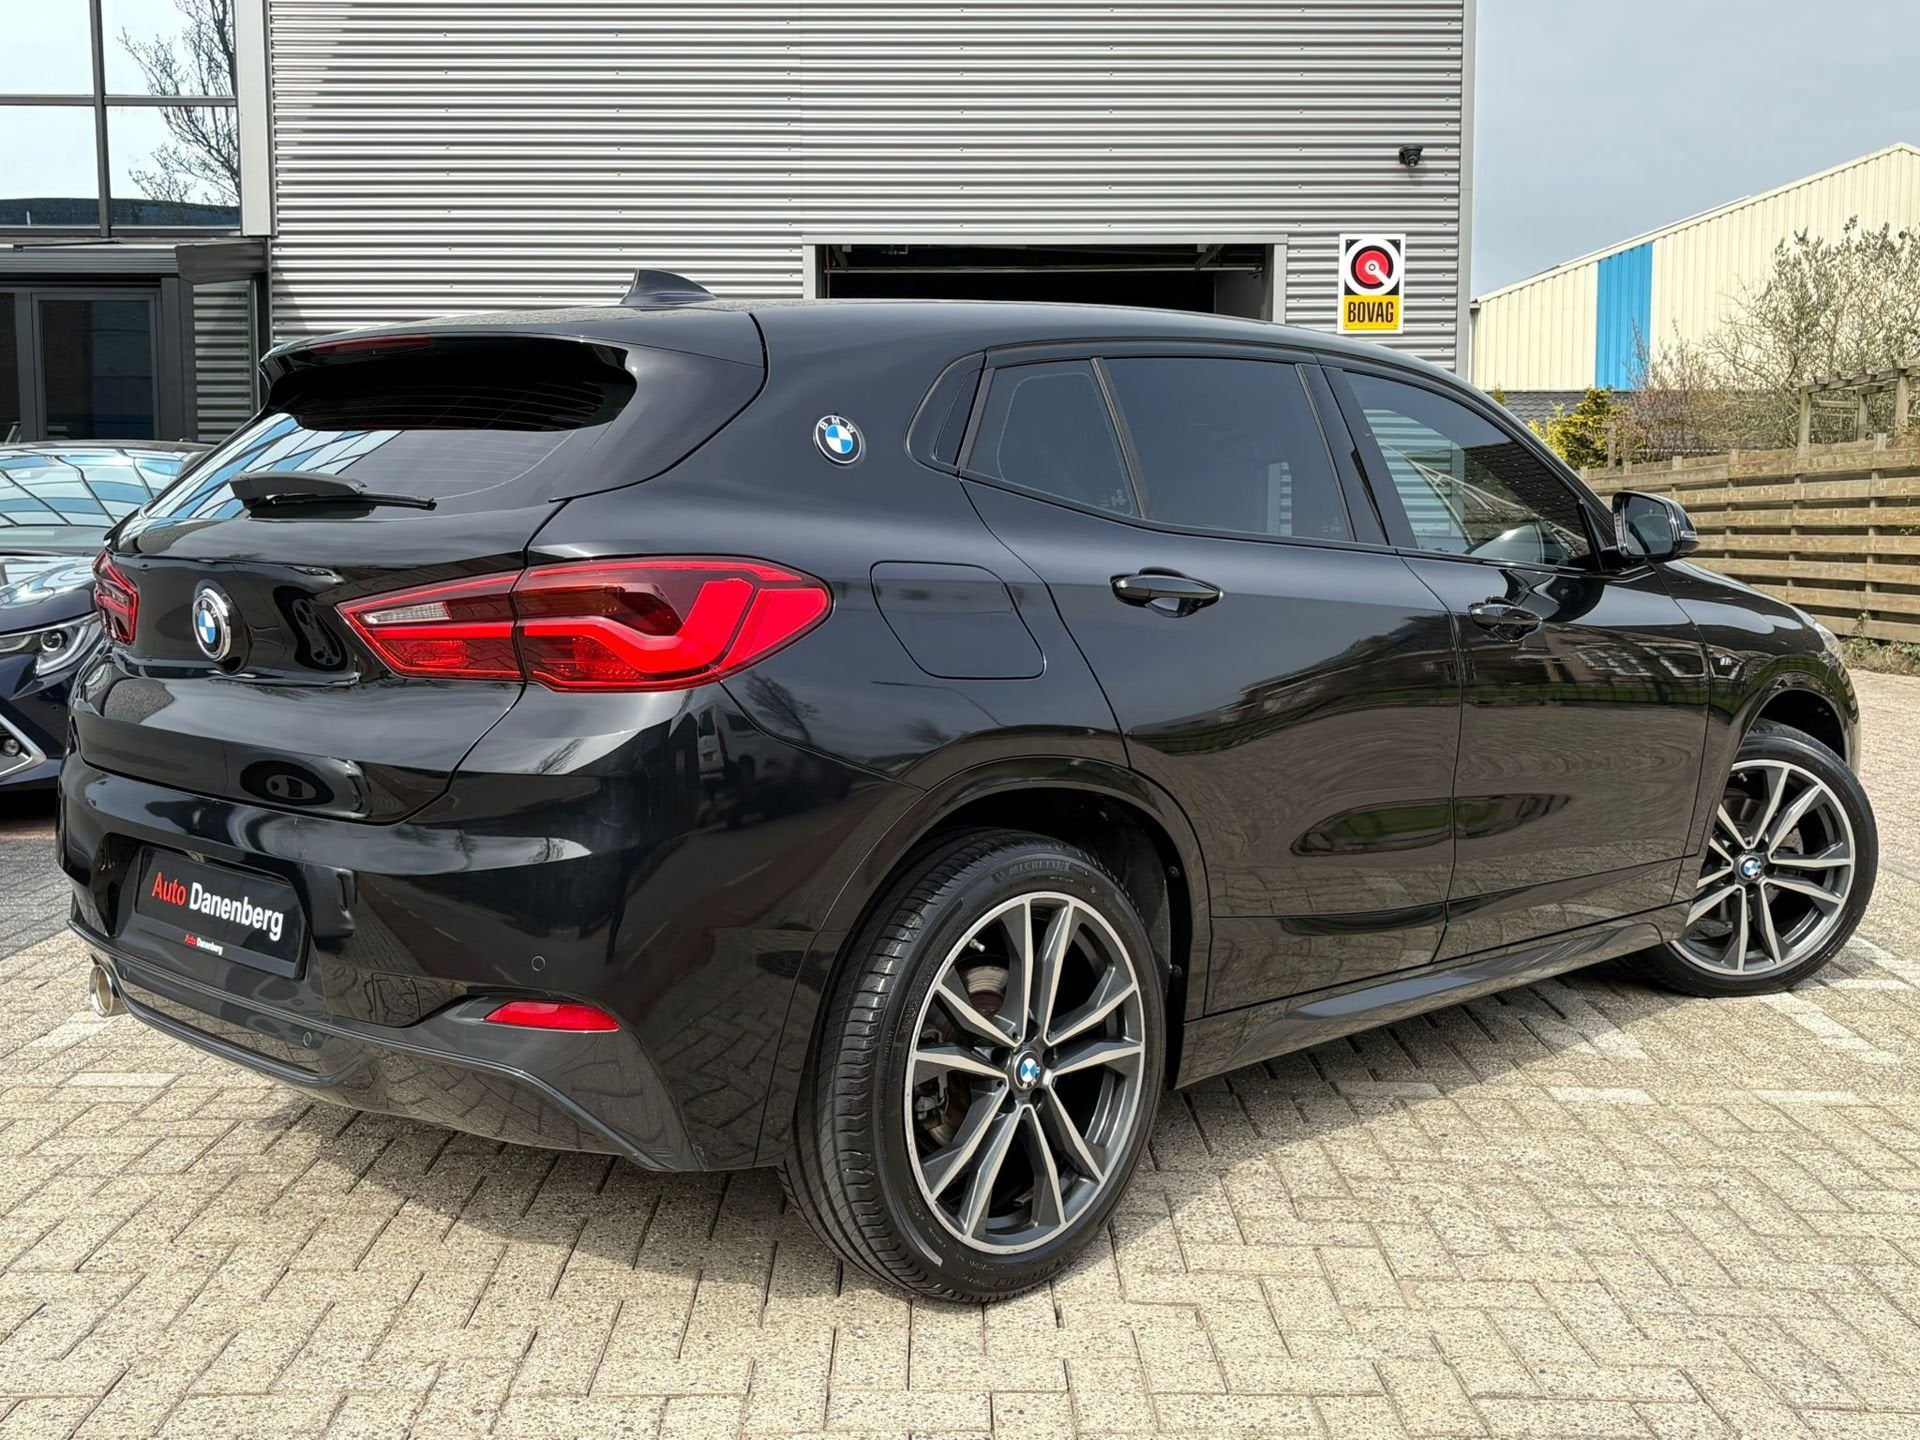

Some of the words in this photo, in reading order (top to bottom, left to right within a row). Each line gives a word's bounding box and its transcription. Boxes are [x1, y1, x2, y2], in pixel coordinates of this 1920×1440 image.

[1348, 301, 1394, 323] BOVAG
[819, 416, 855, 434] BMW
[151, 872, 187, 907] Auto
[189, 882, 284, 942] Danenberg
